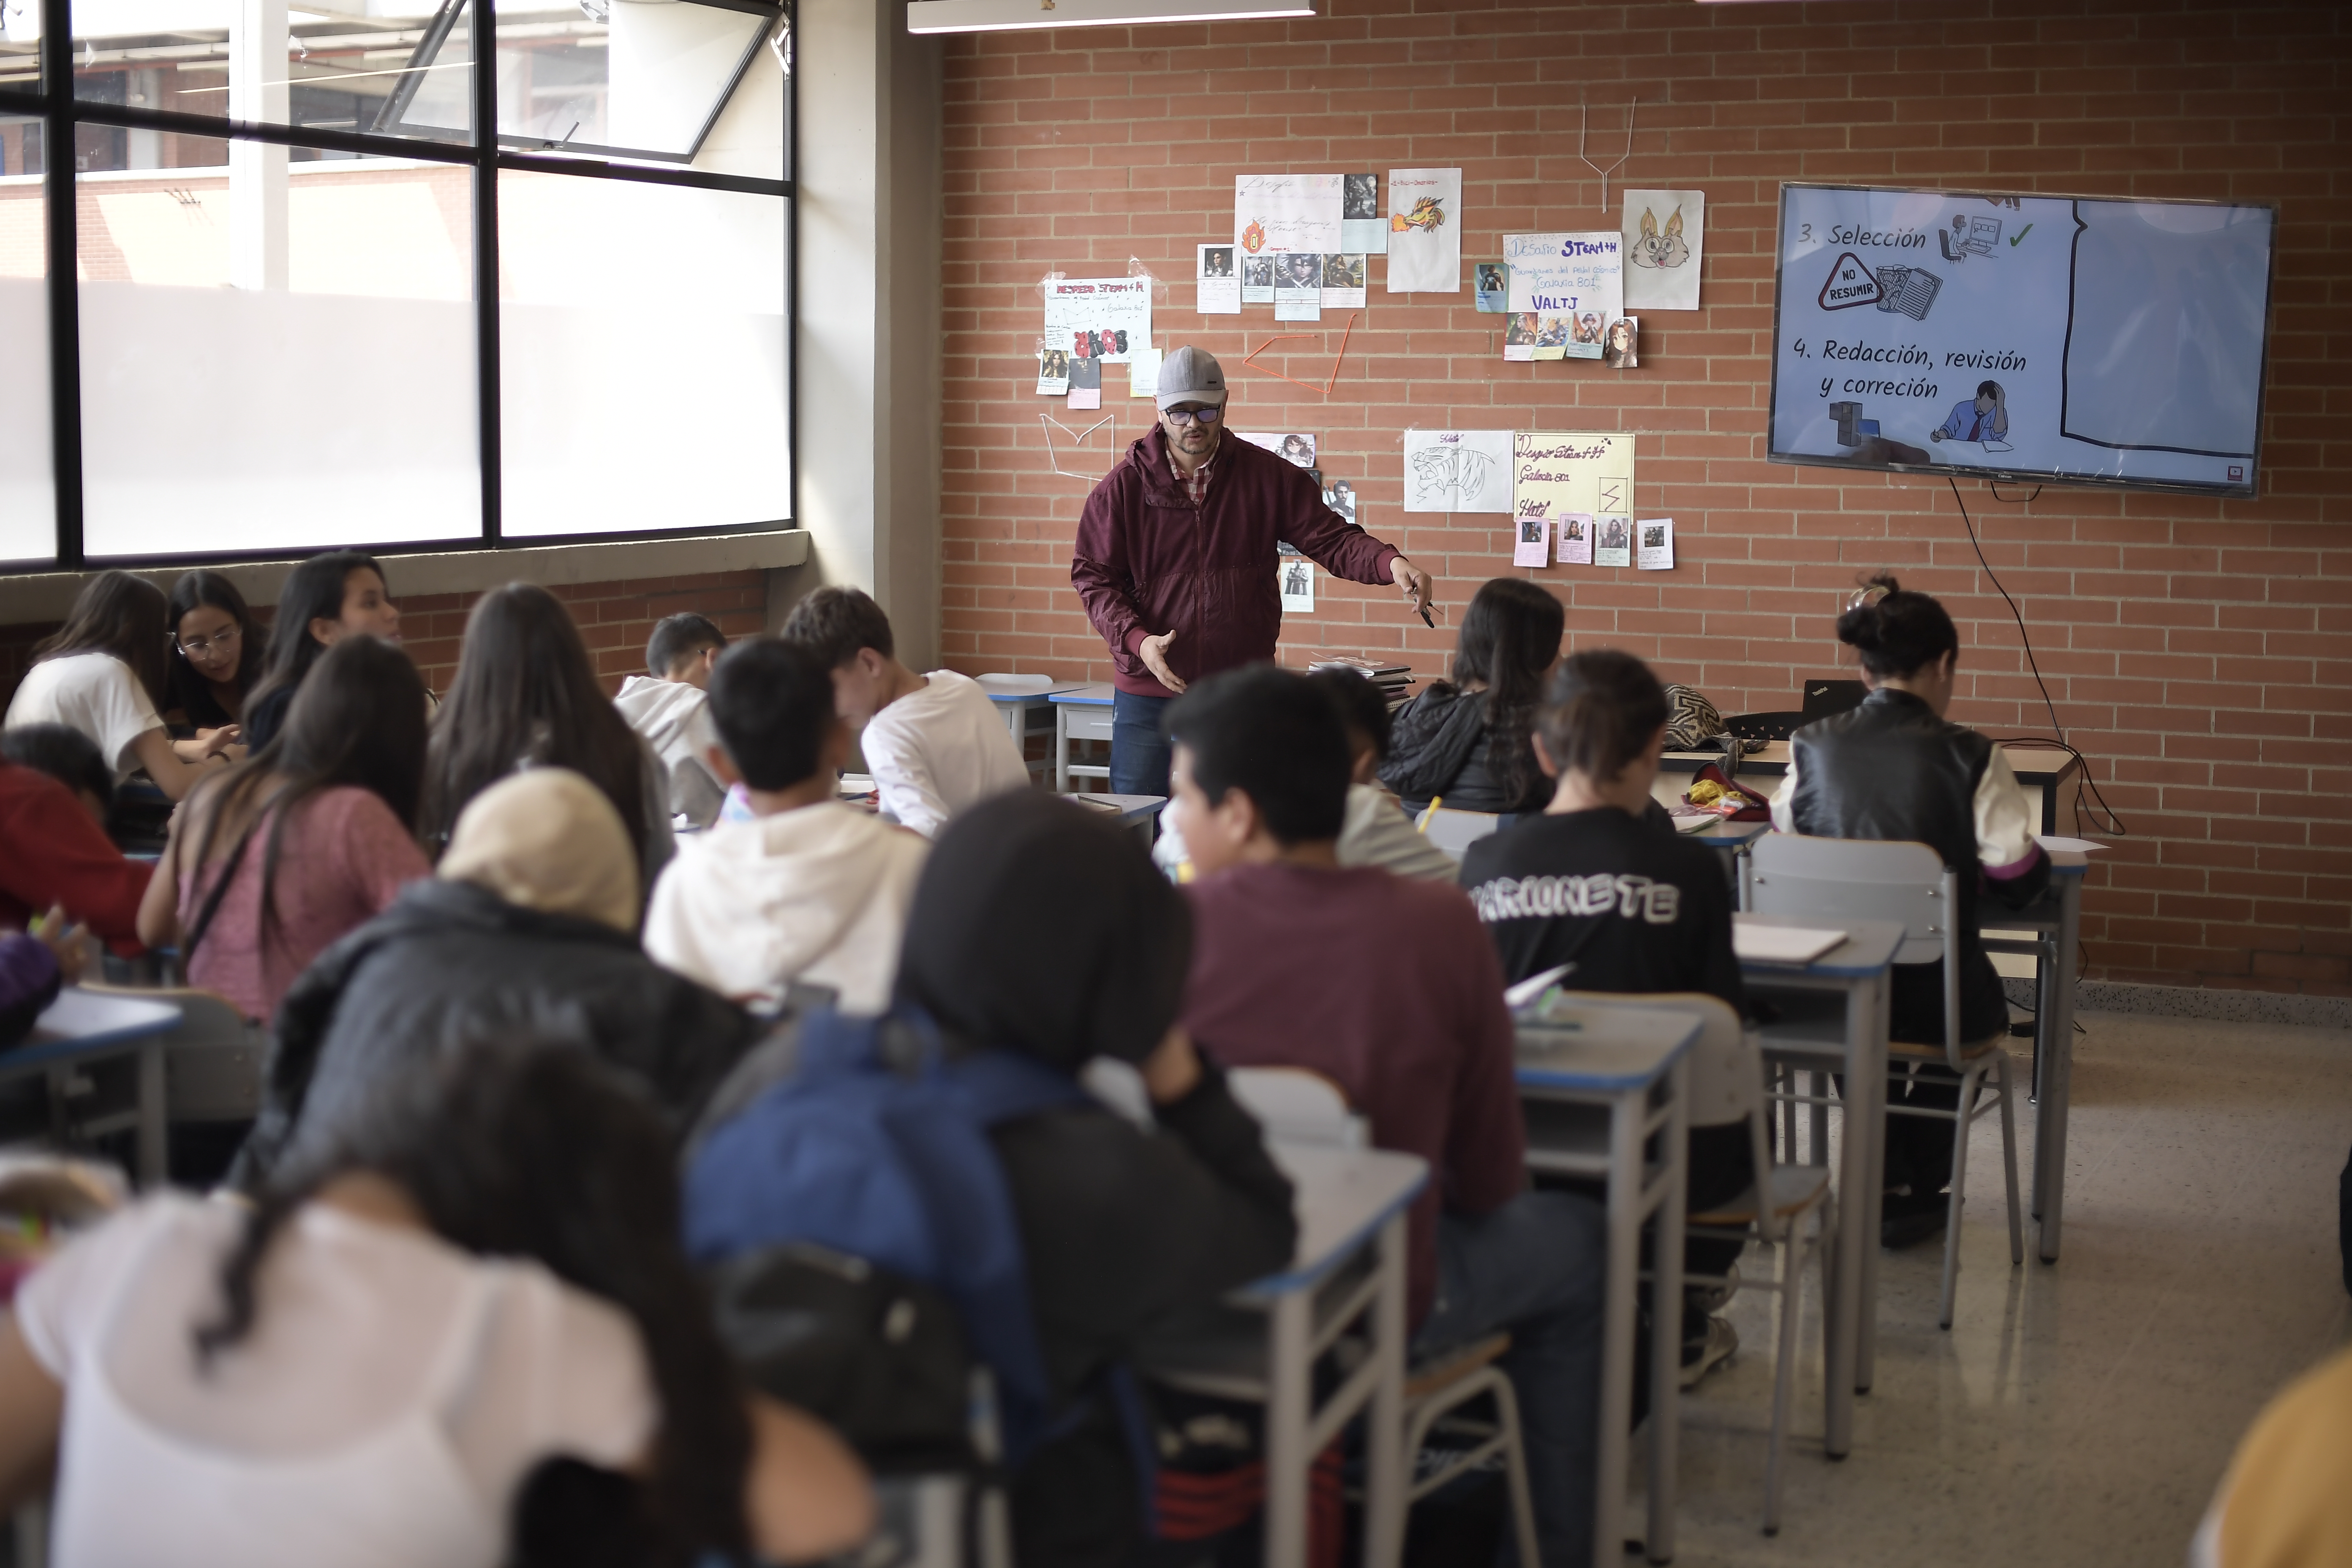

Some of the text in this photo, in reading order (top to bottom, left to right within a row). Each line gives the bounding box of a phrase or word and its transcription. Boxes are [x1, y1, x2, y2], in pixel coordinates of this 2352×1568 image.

[1798, 223, 1926, 249] 3. Selección
[1842, 269, 1856, 282] NO
[1829, 283, 1874, 300] RESUMIR
[1793, 338, 2027, 371] 4. Redacción, revisión
[1819, 377, 1938, 398] y correción
